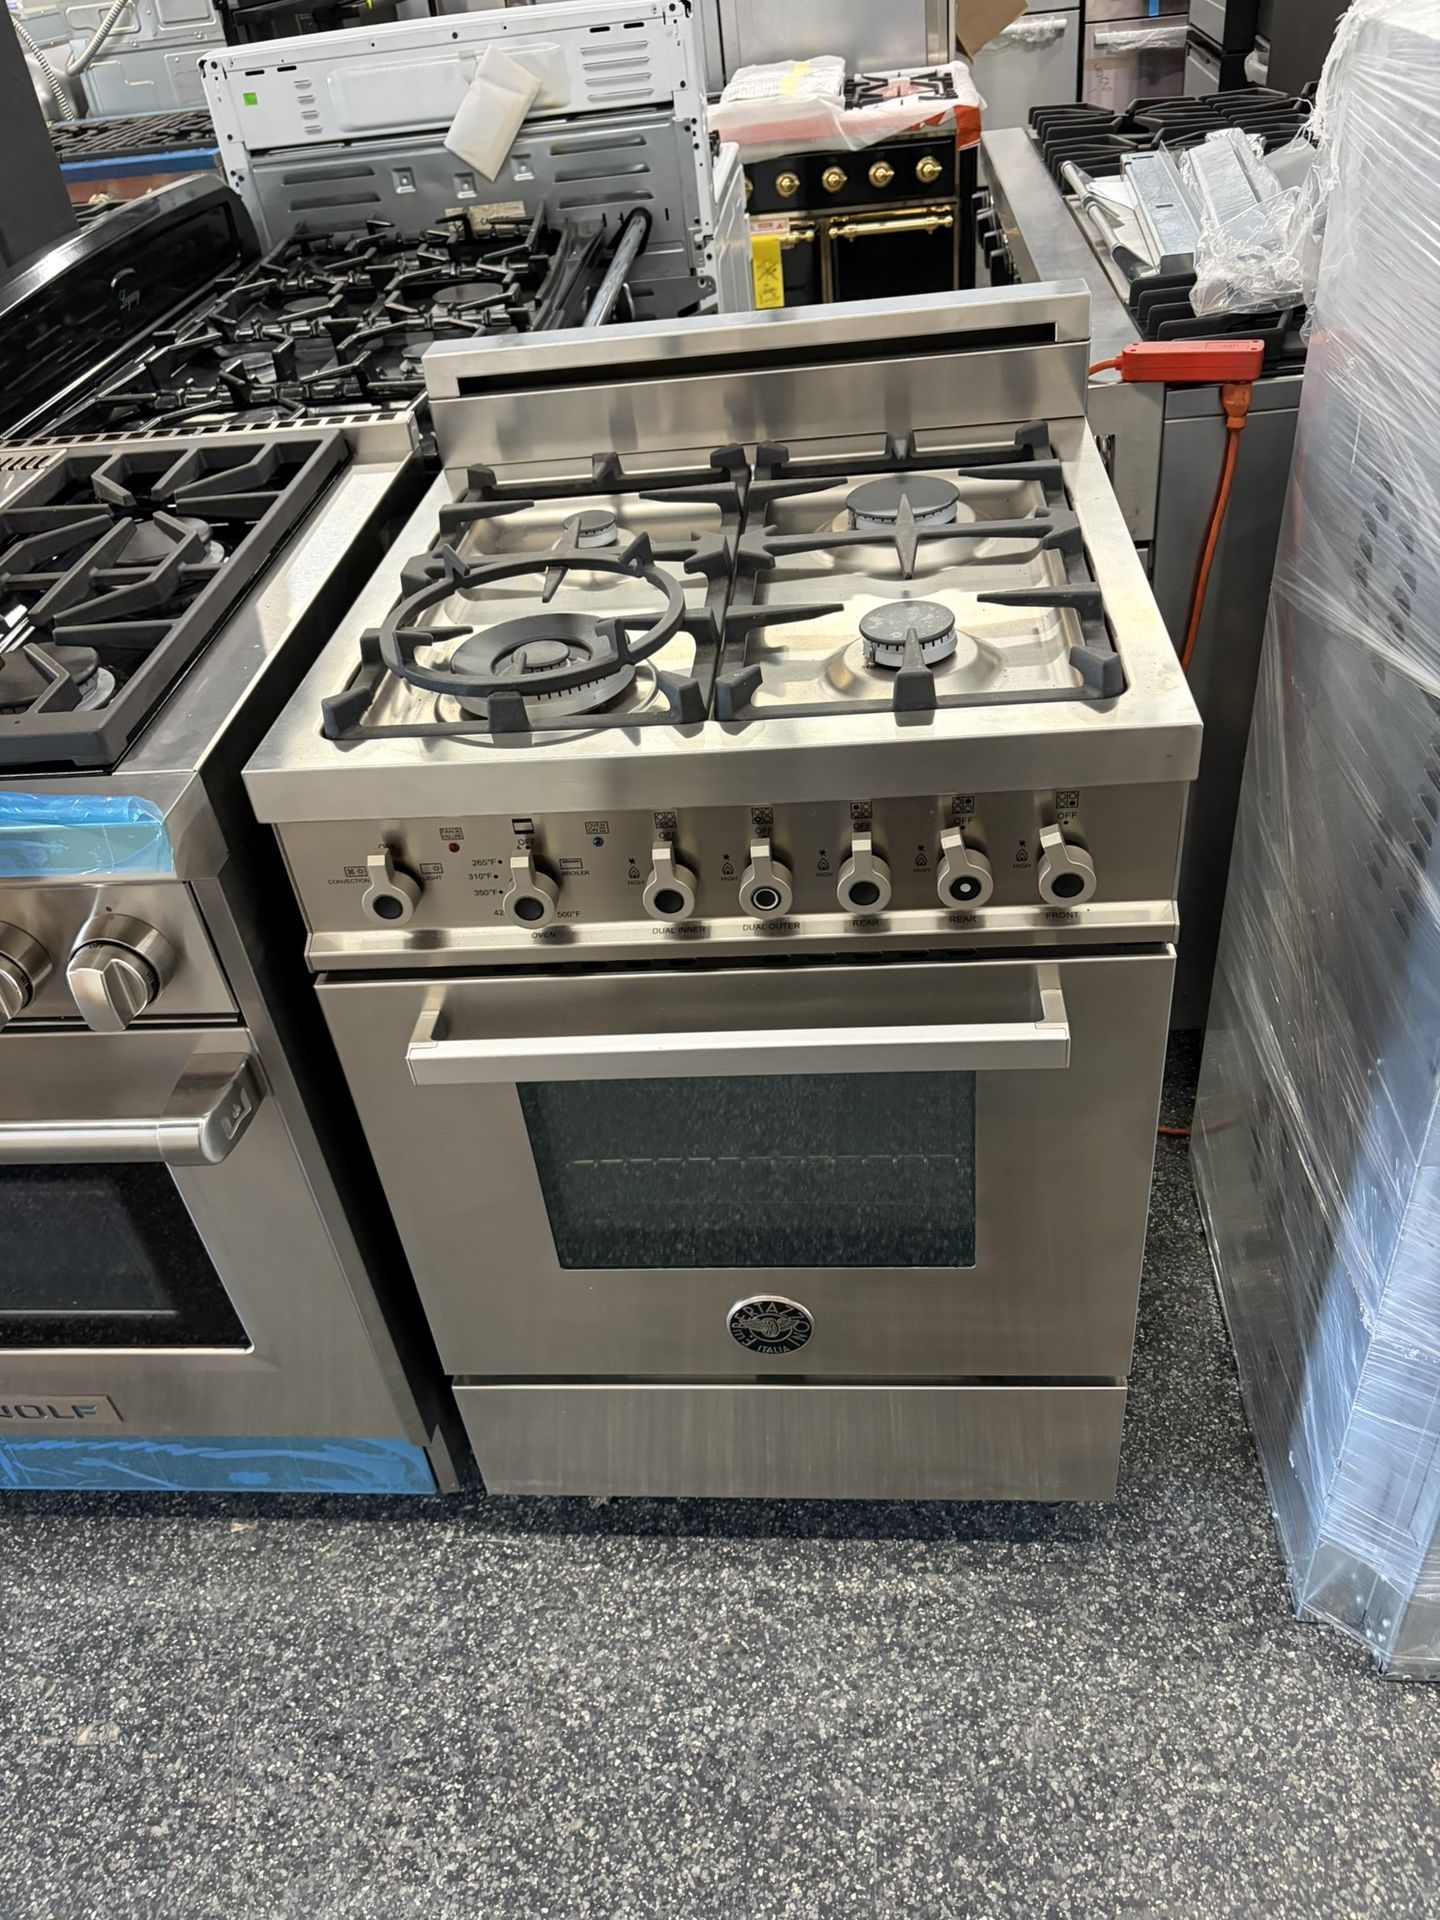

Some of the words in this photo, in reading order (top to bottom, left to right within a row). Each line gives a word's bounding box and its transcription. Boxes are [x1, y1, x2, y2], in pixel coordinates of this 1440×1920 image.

[1056, 811, 1078, 820] OFF
[954, 816, 974, 825] OFF
[471, 859, 497, 867] 265°F
[467, 872, 493, 881] 310°F
[561, 869, 590, 877] BROILER
[327, 878, 370, 886] CONVECTION
[473, 889, 499, 897] 350°F
[556, 910, 582, 919] 500°F
[949, 914, 977, 924] REAR
[1045, 911, 1080, 920] FRONT
[742, 923, 766, 932] DUAL
[768, 921, 801, 930] OUTER
[852, 918, 880, 928] REAR
[651, 926, 676, 935] DUAL
[677, 925, 706, 934] INNER
[531, 931, 557, 939] OVEN
[756, 1344, 792, 1354] ITALIA
